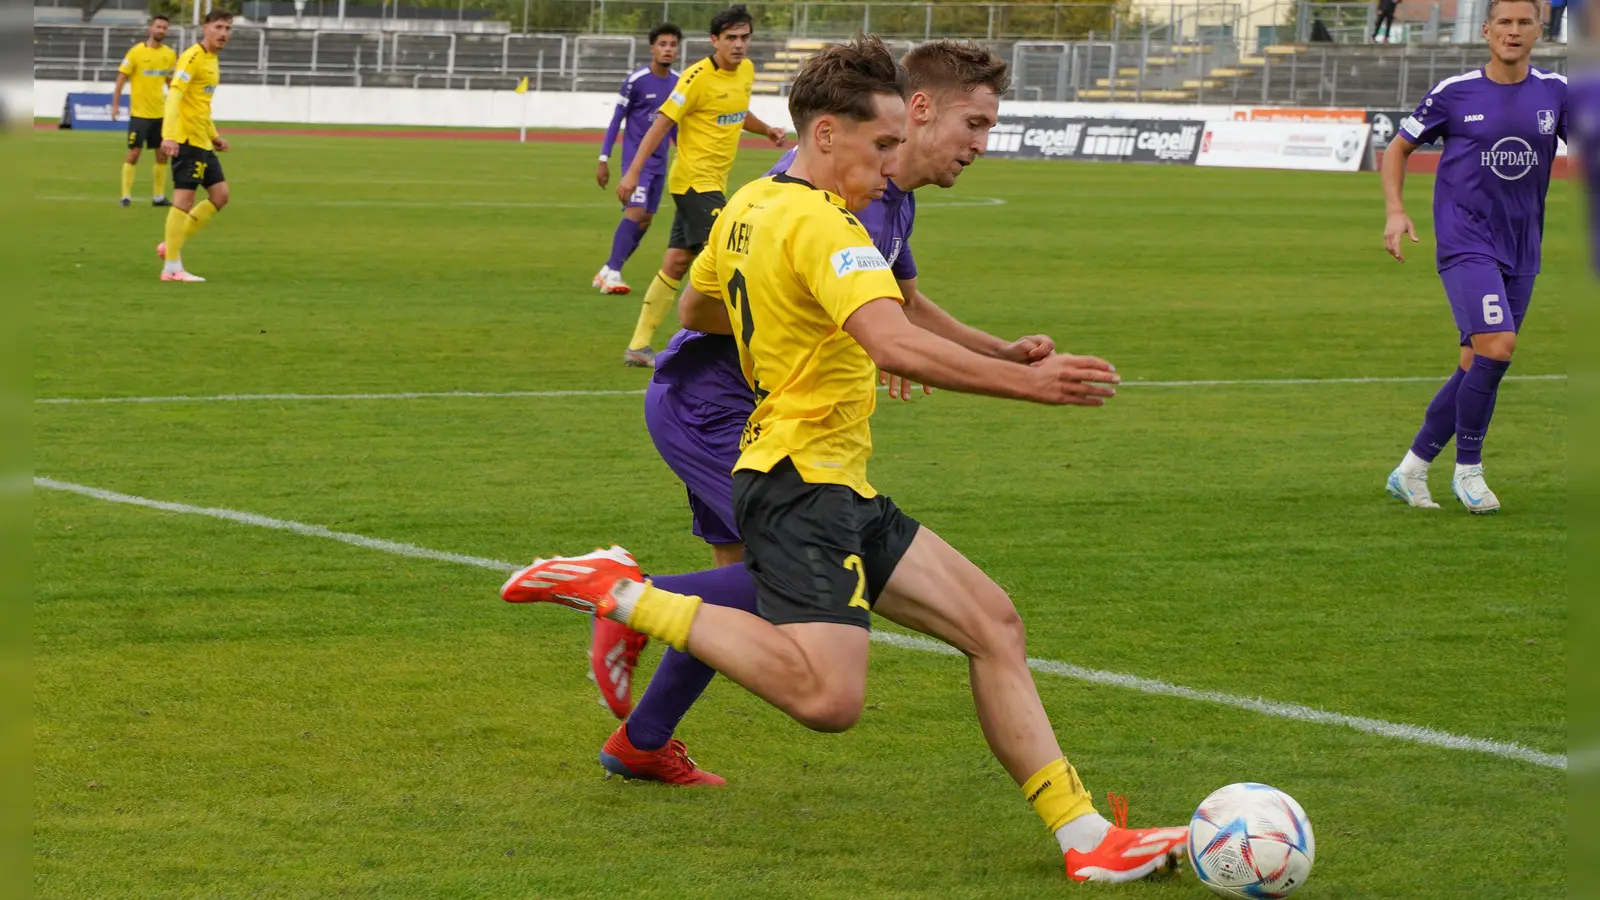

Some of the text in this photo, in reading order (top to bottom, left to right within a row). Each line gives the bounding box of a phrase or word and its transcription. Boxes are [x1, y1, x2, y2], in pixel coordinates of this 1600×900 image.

[1463, 114, 1484, 122] JAKO
[1024, 123, 1082, 153] capelli
[1137, 125, 1198, 157] capelli
[1480, 151, 1539, 167] HYPDATA
[1482, 294, 1504, 325] 6
[843, 554, 871, 611] 2
